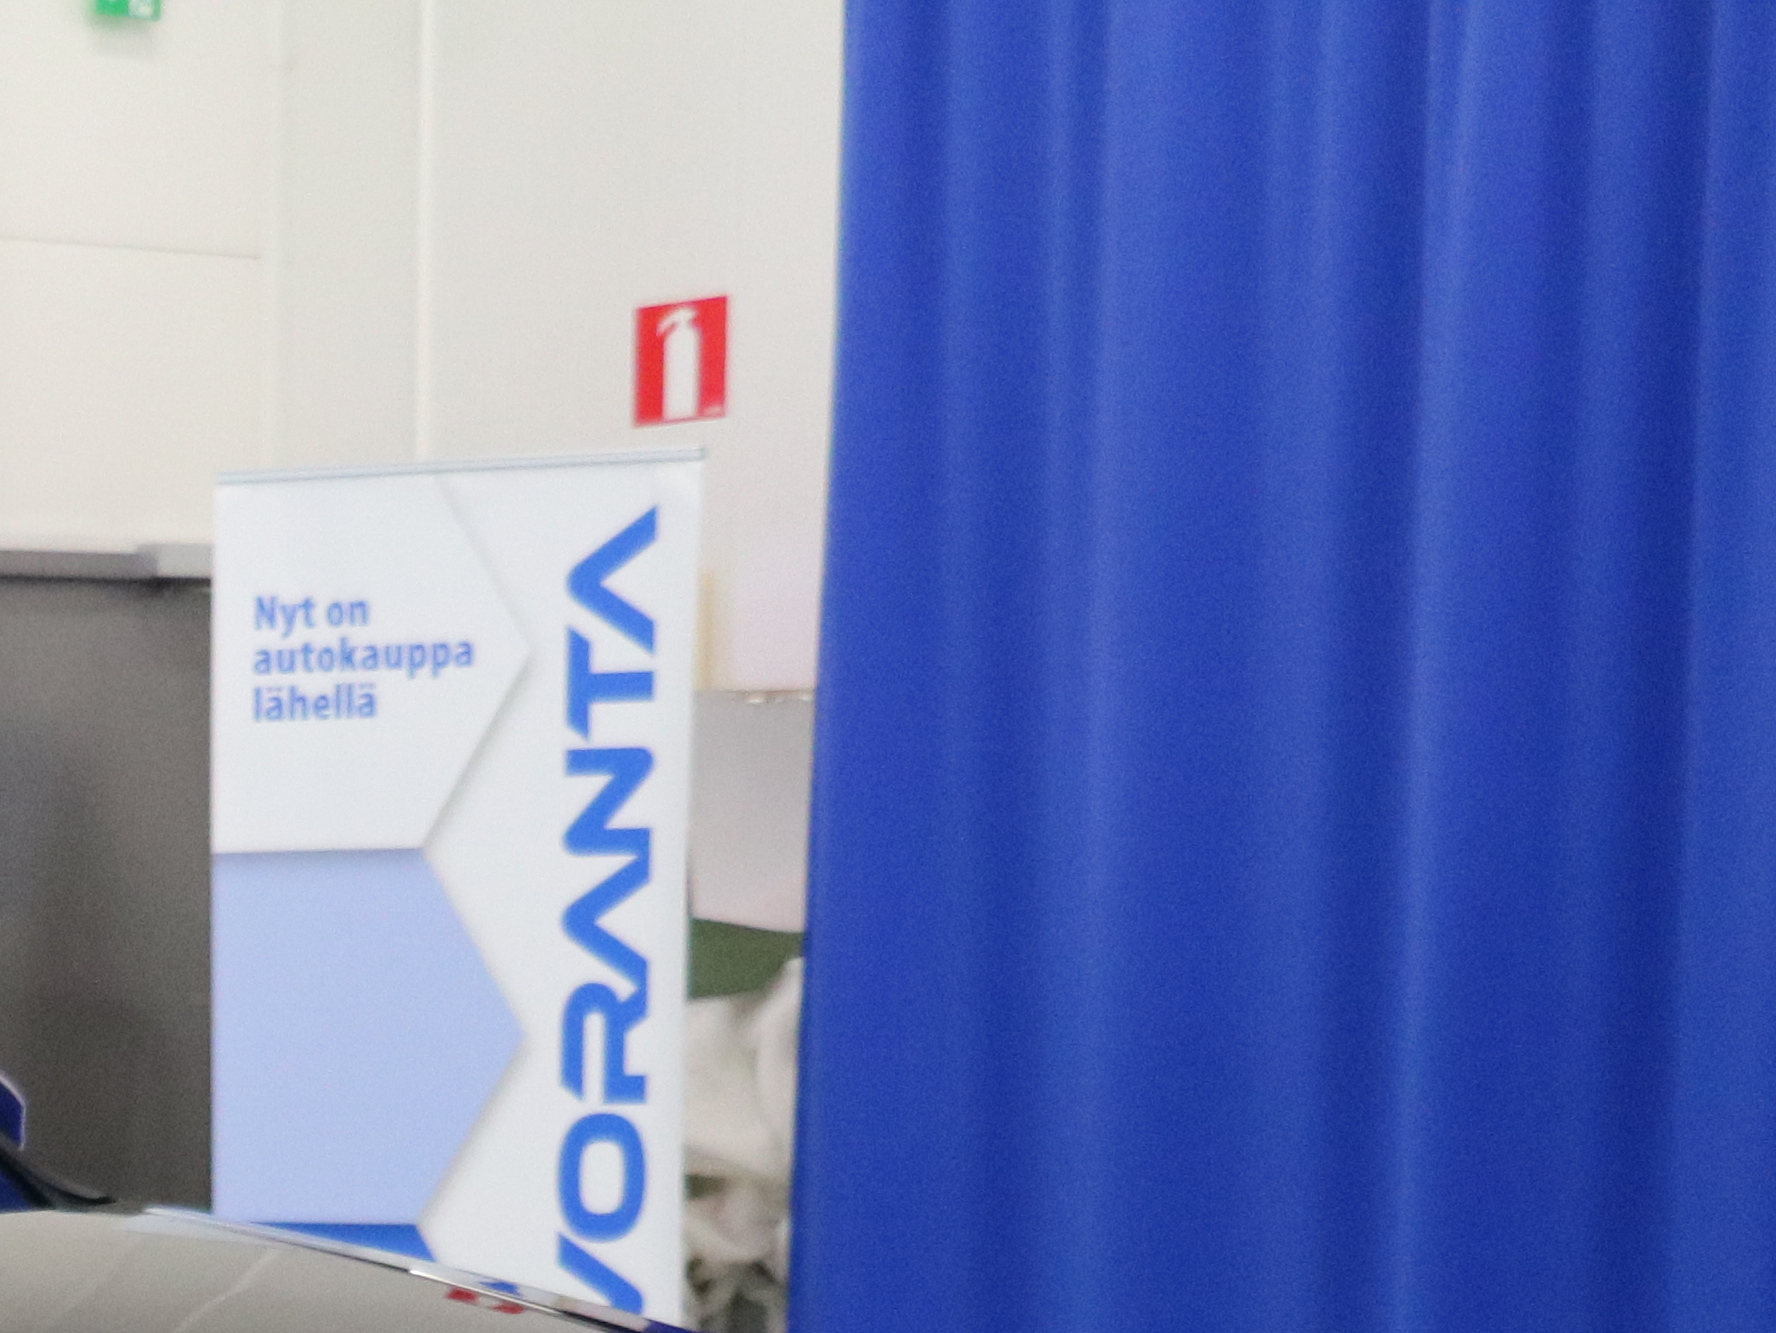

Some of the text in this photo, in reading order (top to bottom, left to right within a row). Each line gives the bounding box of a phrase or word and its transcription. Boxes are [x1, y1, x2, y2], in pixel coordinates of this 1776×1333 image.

[254, 596, 370, 638] Nyt on
[253, 637, 475, 679] autokauppa
[252, 683, 378, 721] lähellä
